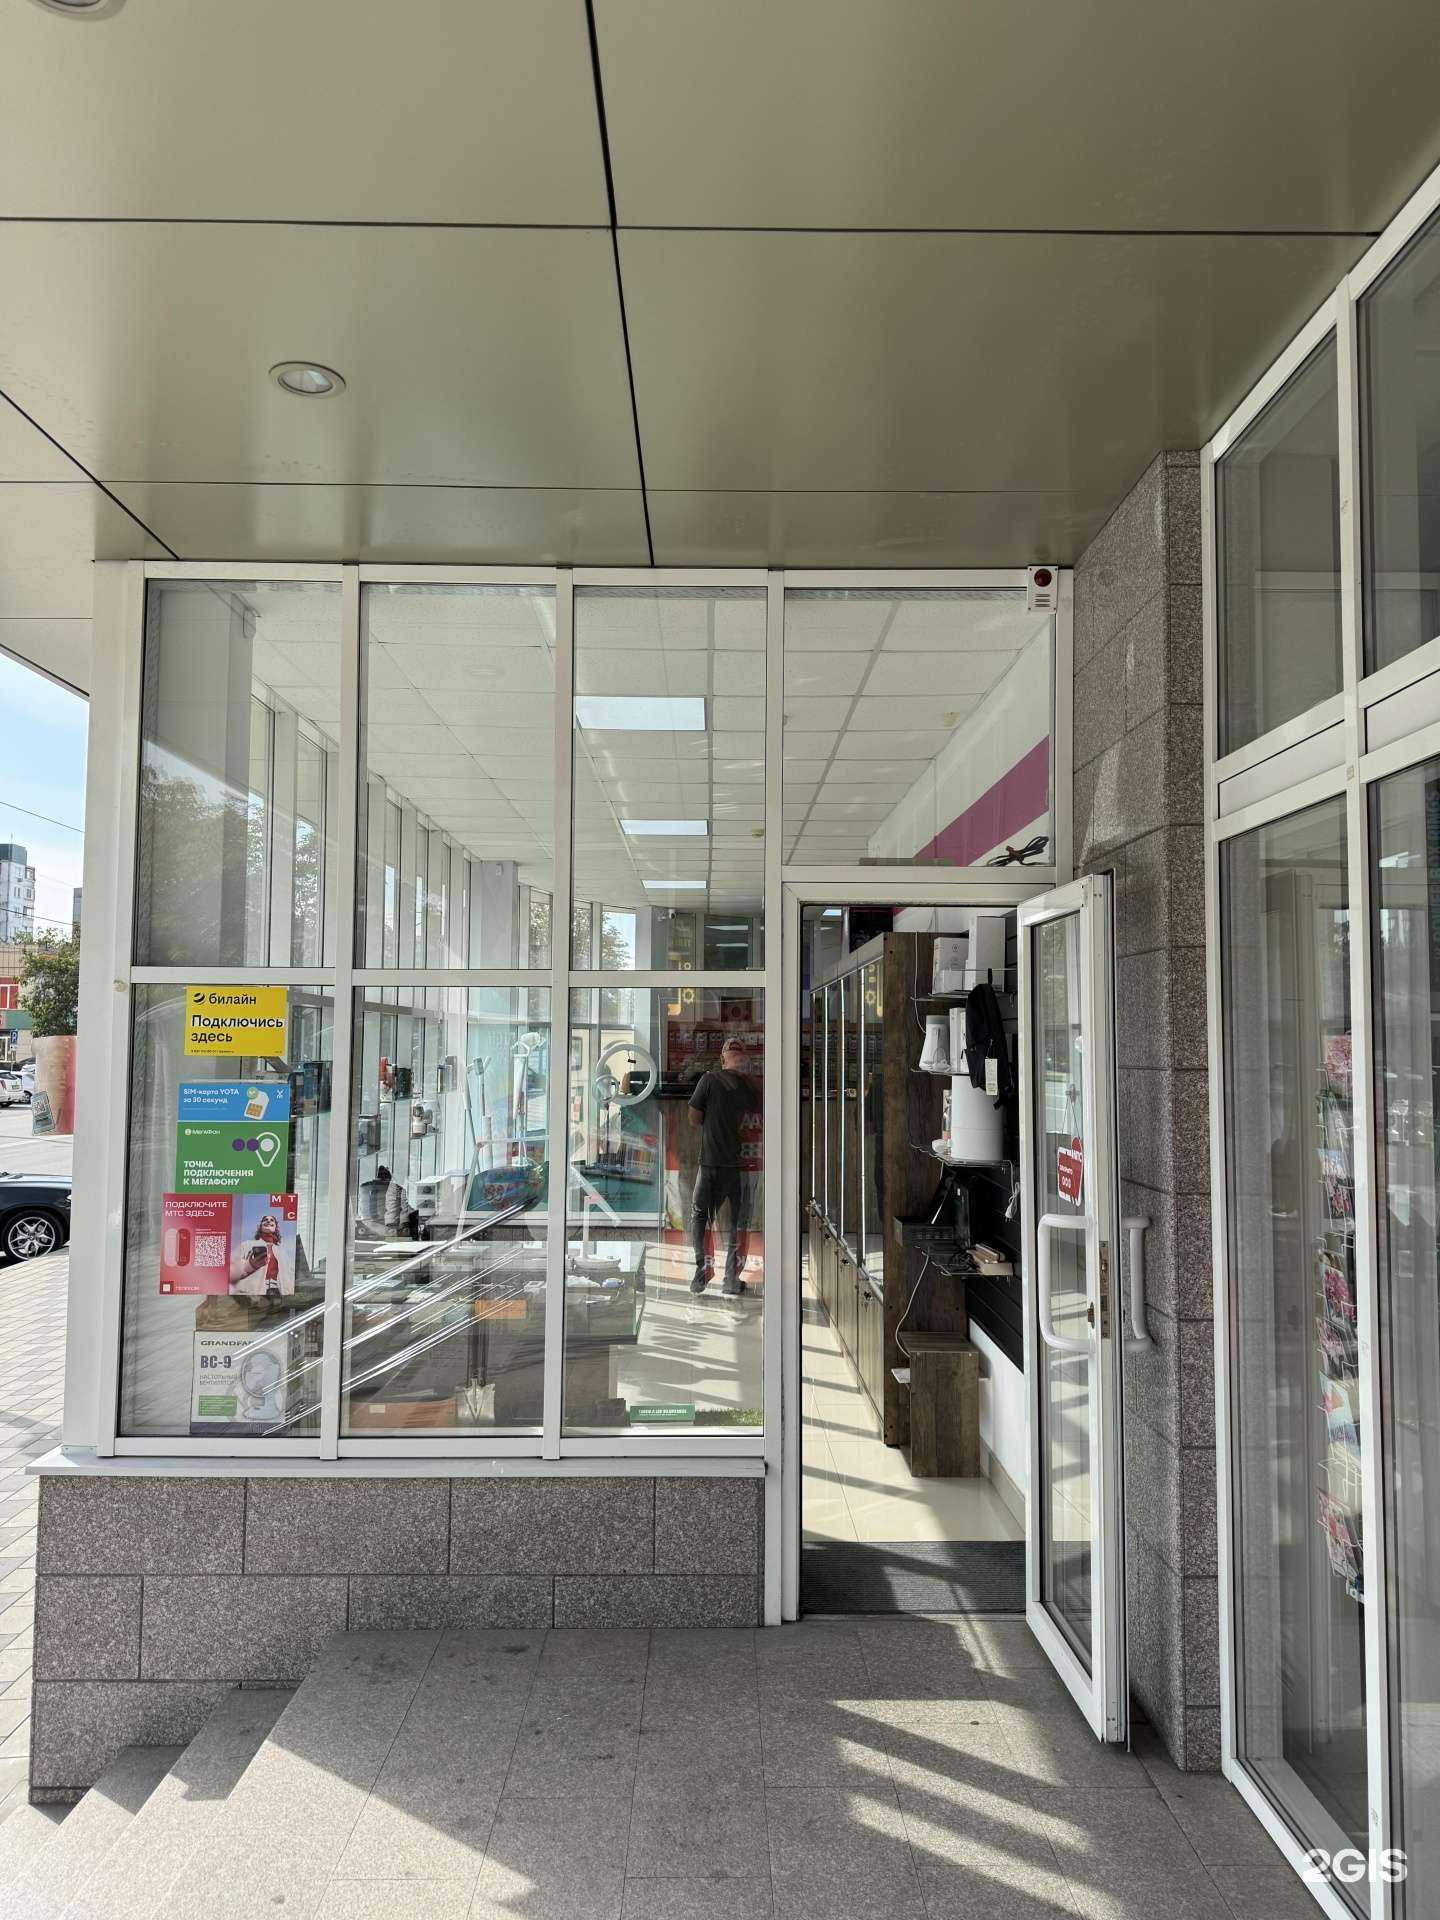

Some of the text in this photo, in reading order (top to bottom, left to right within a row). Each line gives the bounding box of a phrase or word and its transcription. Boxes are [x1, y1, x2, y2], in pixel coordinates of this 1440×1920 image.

[208, 992, 257, 1005] билайн
[192, 1014, 283, 1029] Подключись
[191, 1032, 233, 1043] здесь
[220, 1088, 240, 1096] YOTA
[183, 1160, 214, 1168] ТОЧКА
[183, 1169, 254, 1177] ПОДКЛЮЧЕНИЯ
[183, 1178, 240, 1186] К МЕГАФОНУ
[165, 1201, 228, 1209] ПОДКЛЮЧИТЕ
[185, 1210, 215, 1218] ЗДЕСЬ
[200, 1355, 232, 1369] BC-9
